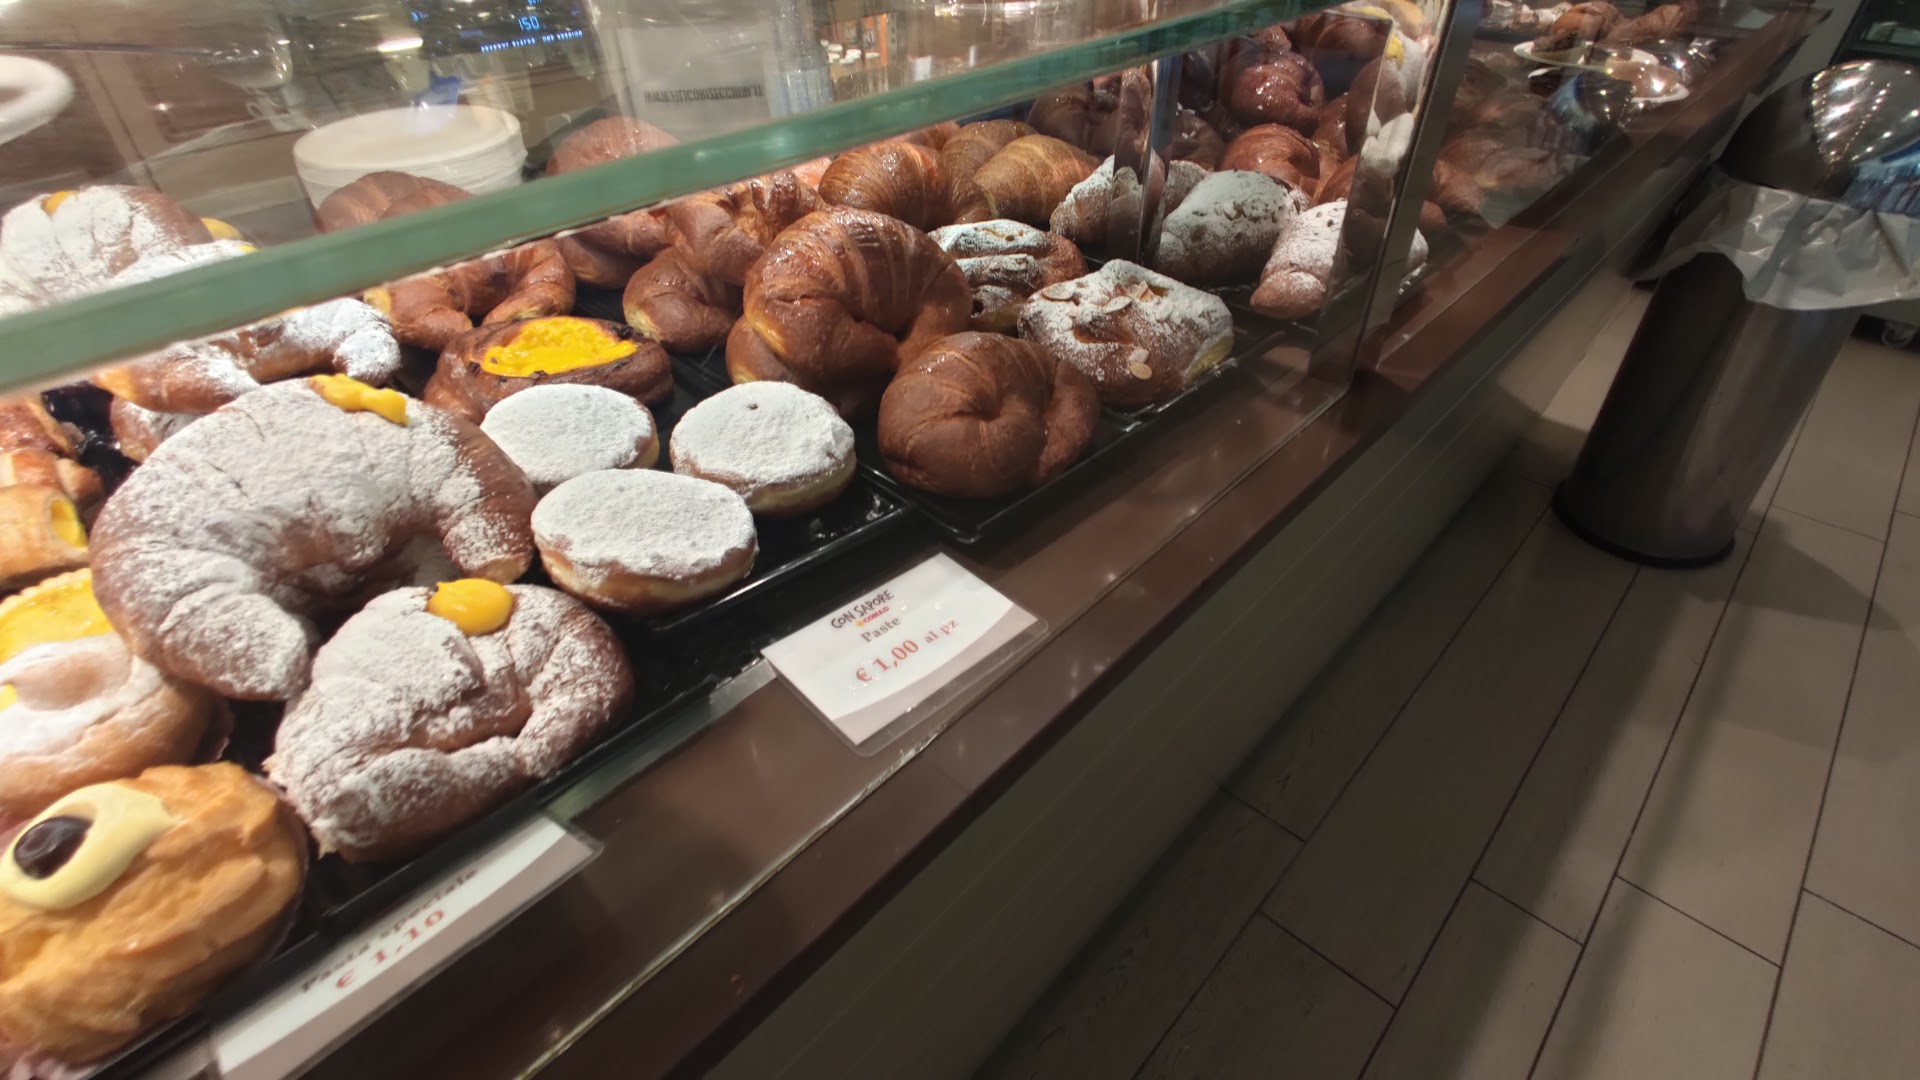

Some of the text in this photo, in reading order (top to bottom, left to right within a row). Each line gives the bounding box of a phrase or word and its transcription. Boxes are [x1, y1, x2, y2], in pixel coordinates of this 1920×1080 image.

[517, 15, 541, 32] 150
[831, 589, 895, 629] CON SAPORE
[863, 606, 890, 623] CONAD
[861, 617, 902, 643] Paste
[873, 640, 919, 672] 1,00
[924, 631, 939, 643] al
[940, 619, 959, 636] pz
